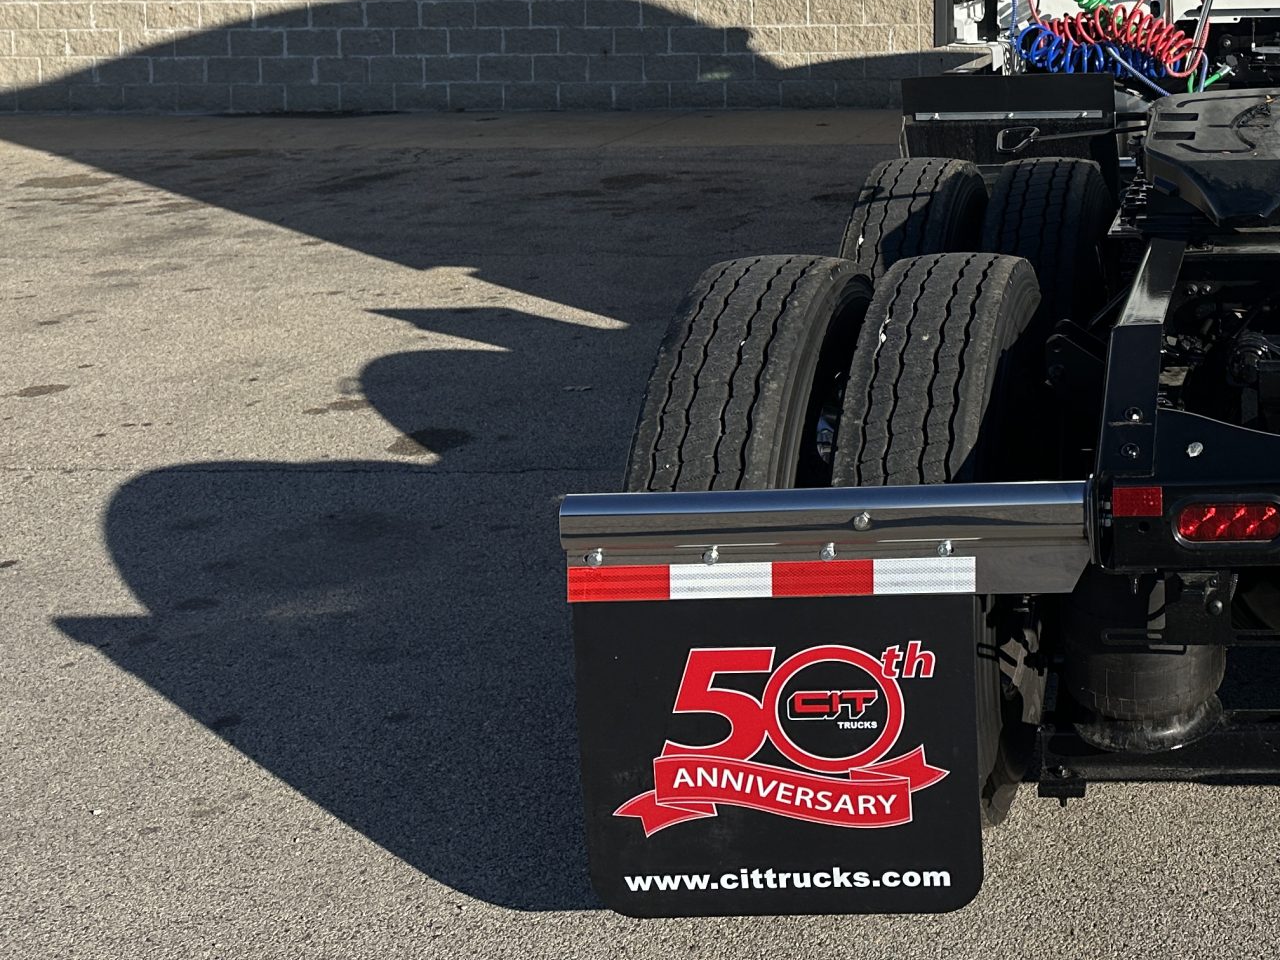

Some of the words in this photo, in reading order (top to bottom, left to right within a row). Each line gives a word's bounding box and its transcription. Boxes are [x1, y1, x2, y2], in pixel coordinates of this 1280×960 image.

[661, 641, 936, 774] 50th
[787, 690, 878, 720] CIT
[837, 721, 877, 729] TRUCKS
[672, 767, 897, 816] ANNIVERSARY
[624, 867, 951, 892] www.cittrucks.com
